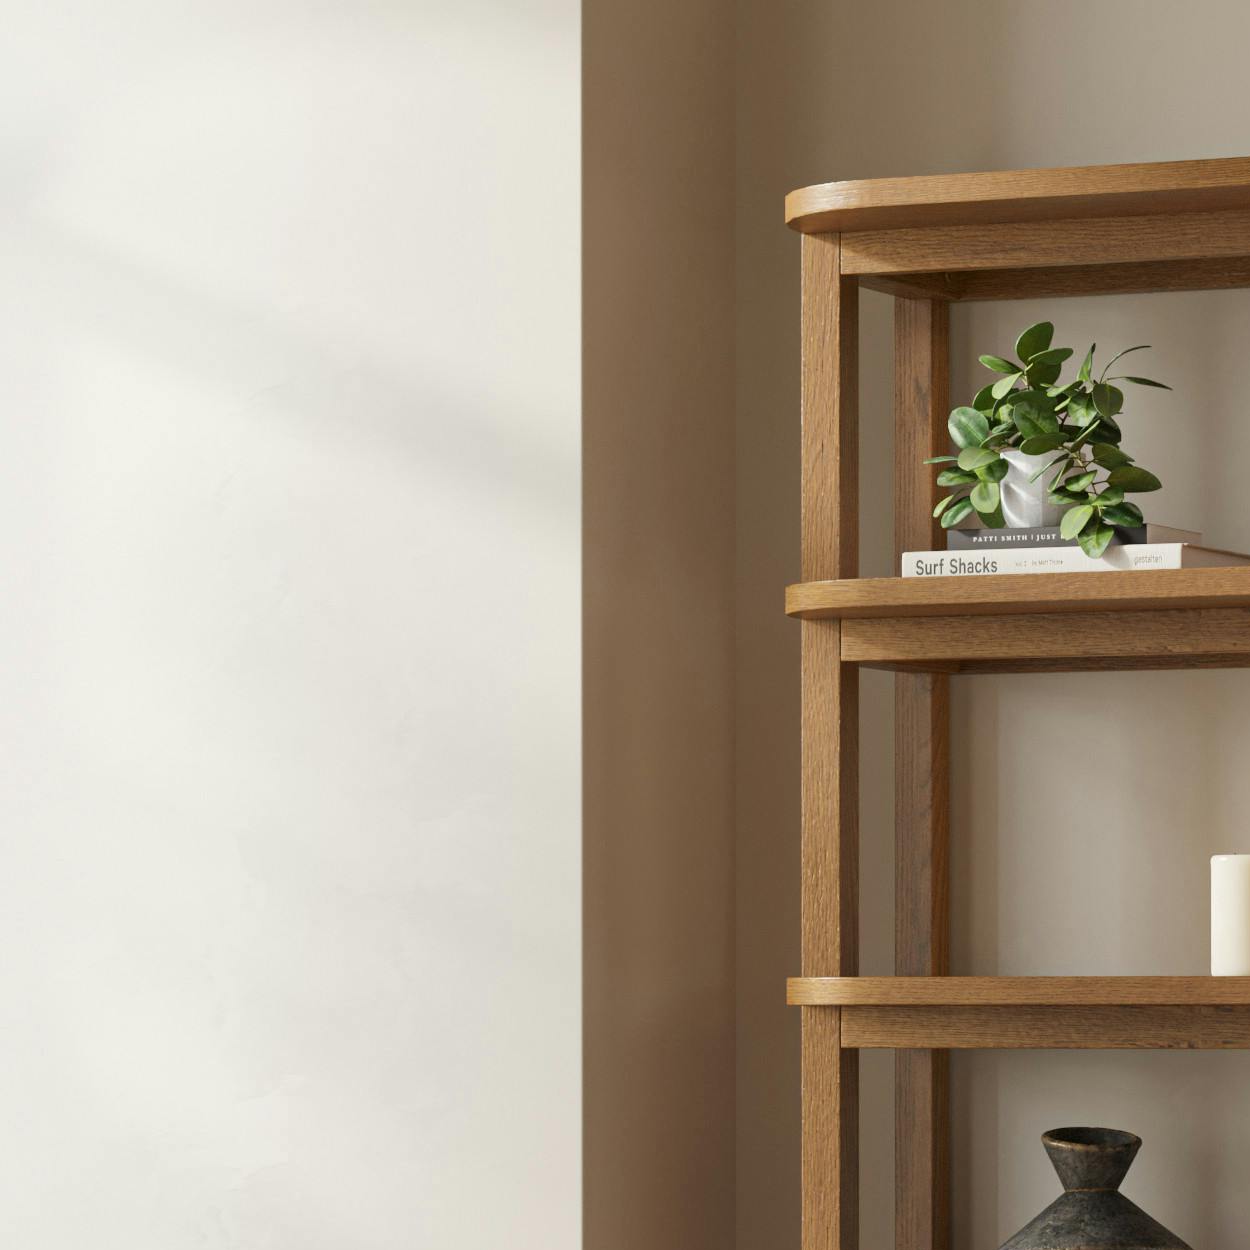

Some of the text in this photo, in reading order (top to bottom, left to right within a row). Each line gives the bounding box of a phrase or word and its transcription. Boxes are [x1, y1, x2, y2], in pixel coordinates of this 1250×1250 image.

[972, 535, 998, 543] PATTI
[1001, 534, 1028, 542] SMITH
[1036, 533, 1057, 542] JUST
[915, 557, 998, 576] Surf Shacks
[1134, 556, 1163, 567] gestalten
